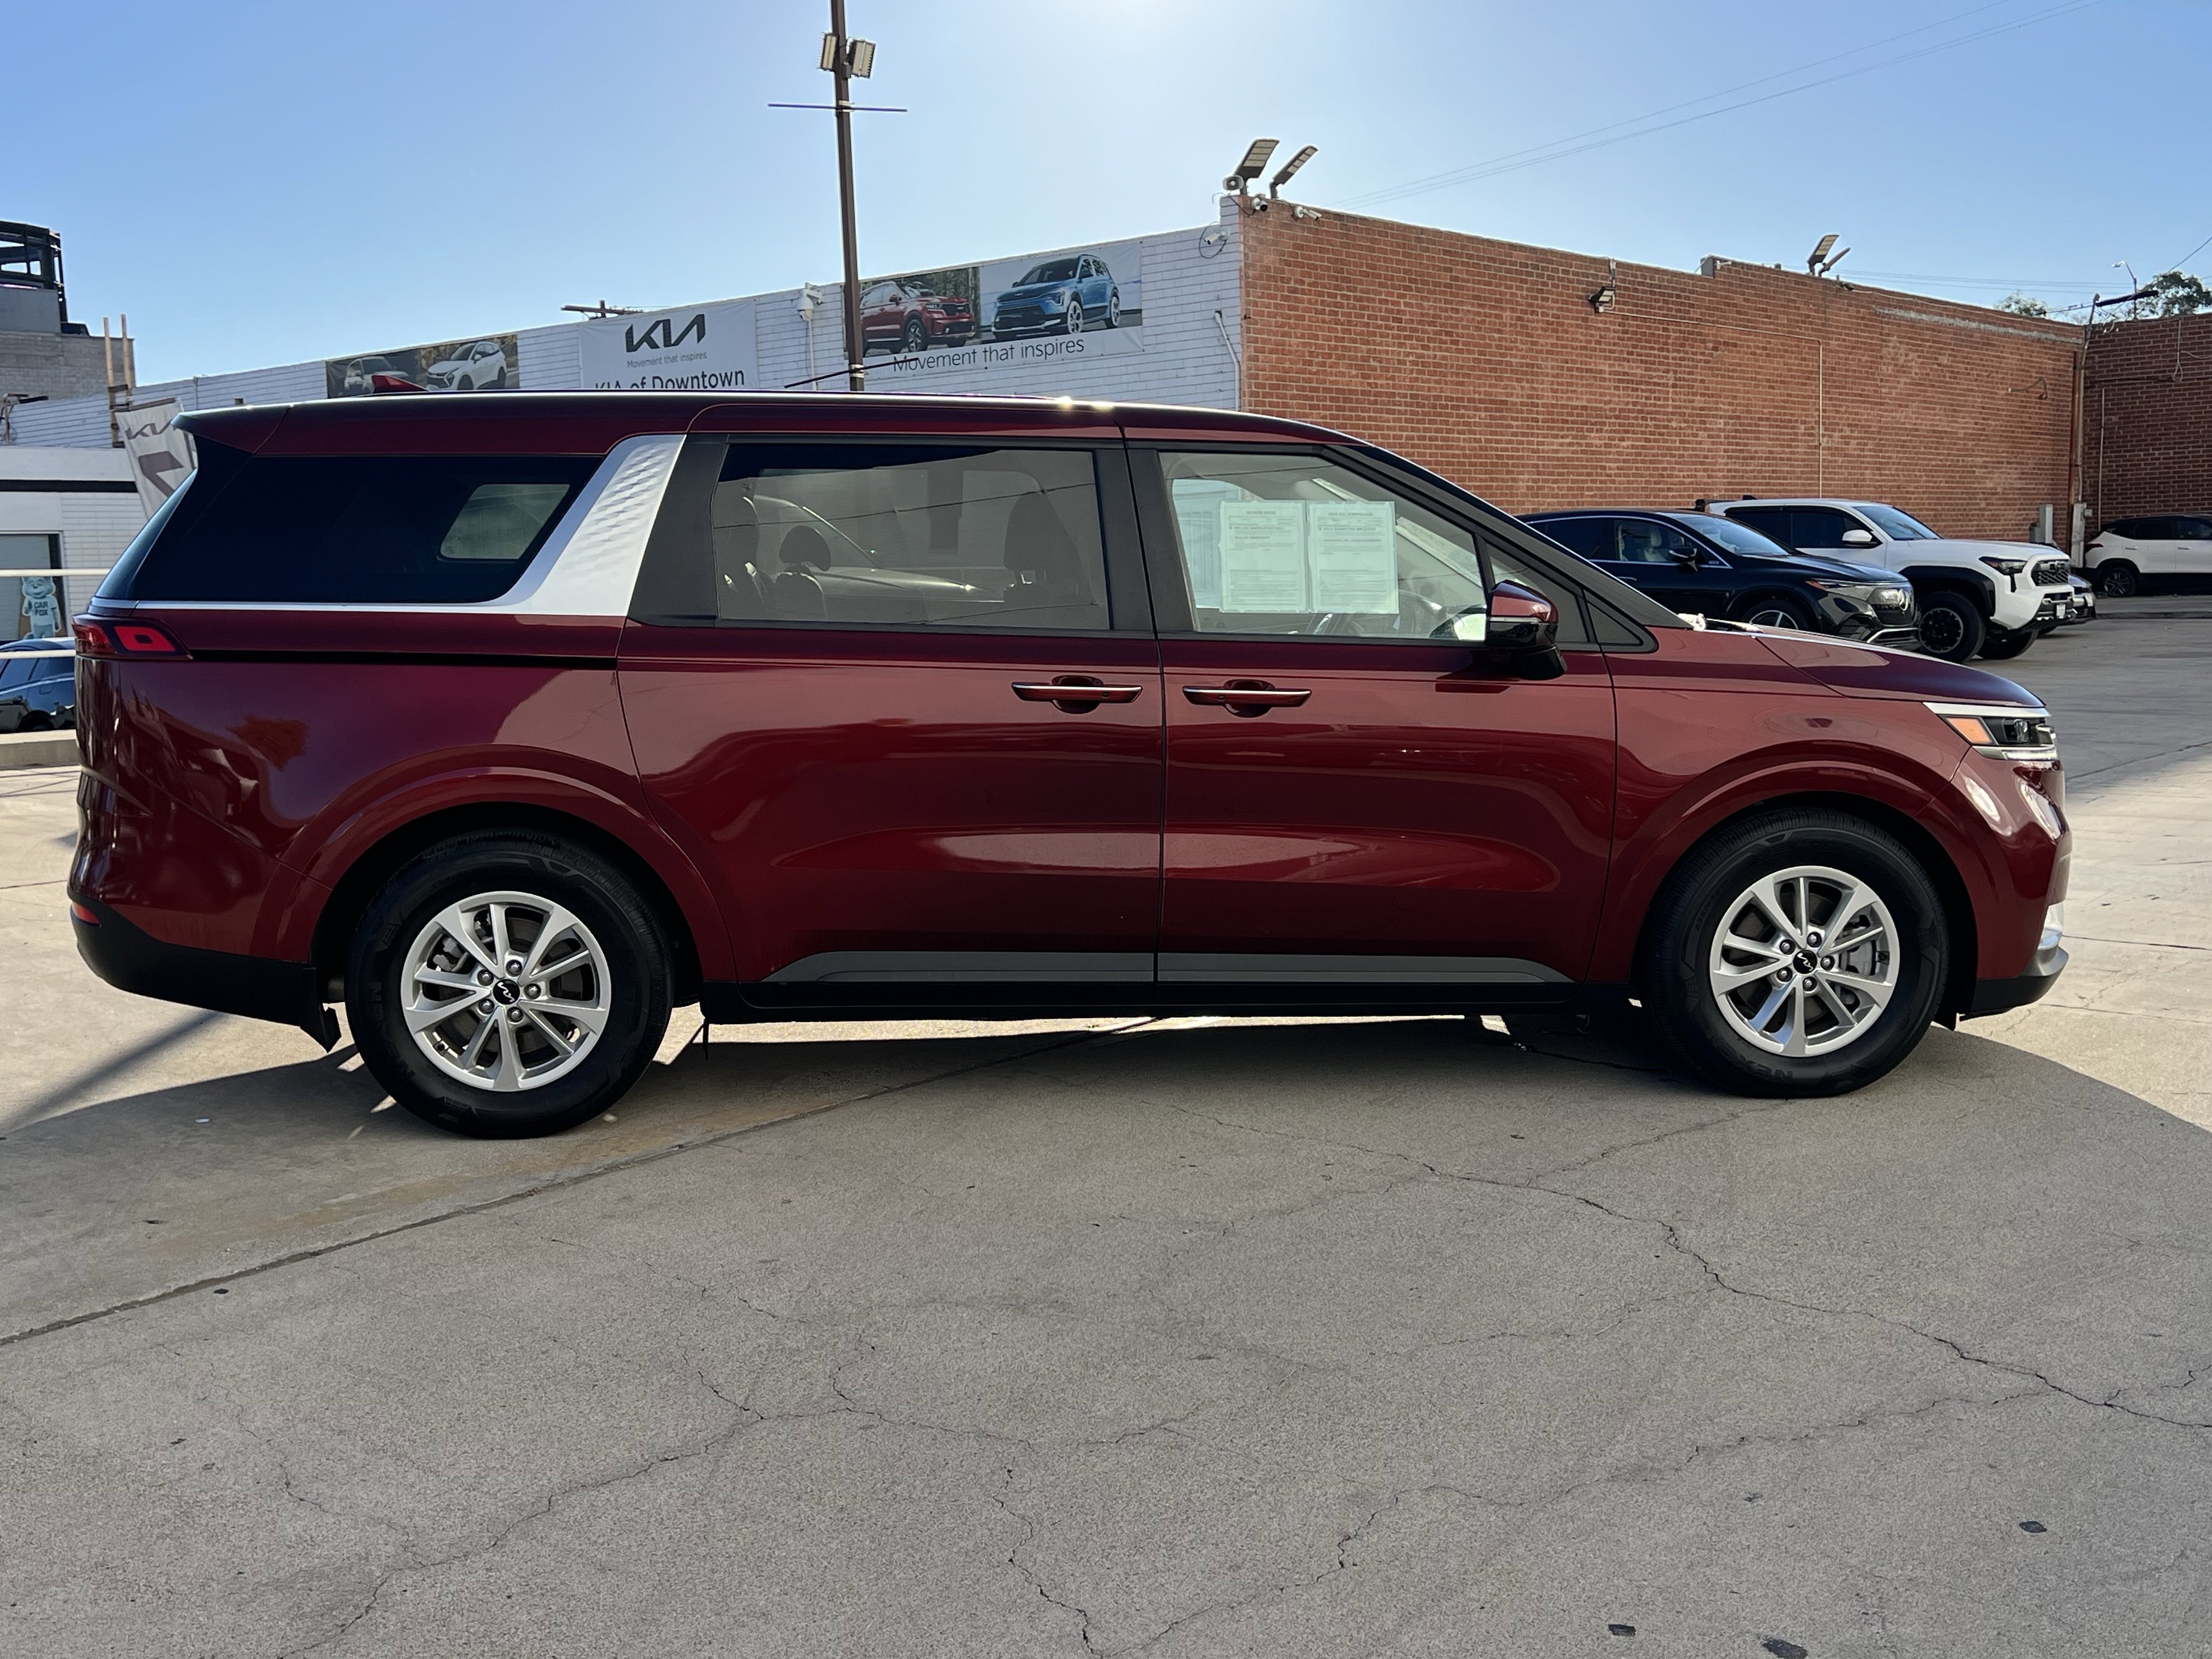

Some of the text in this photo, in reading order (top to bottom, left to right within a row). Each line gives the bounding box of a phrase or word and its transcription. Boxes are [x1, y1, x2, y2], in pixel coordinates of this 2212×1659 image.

[625, 314, 706, 353] KIA
[627, 352, 707, 369] Movement that inspires
[894, 337, 1085, 373] Movement that inspires
[652, 370, 744, 389] Downtown
